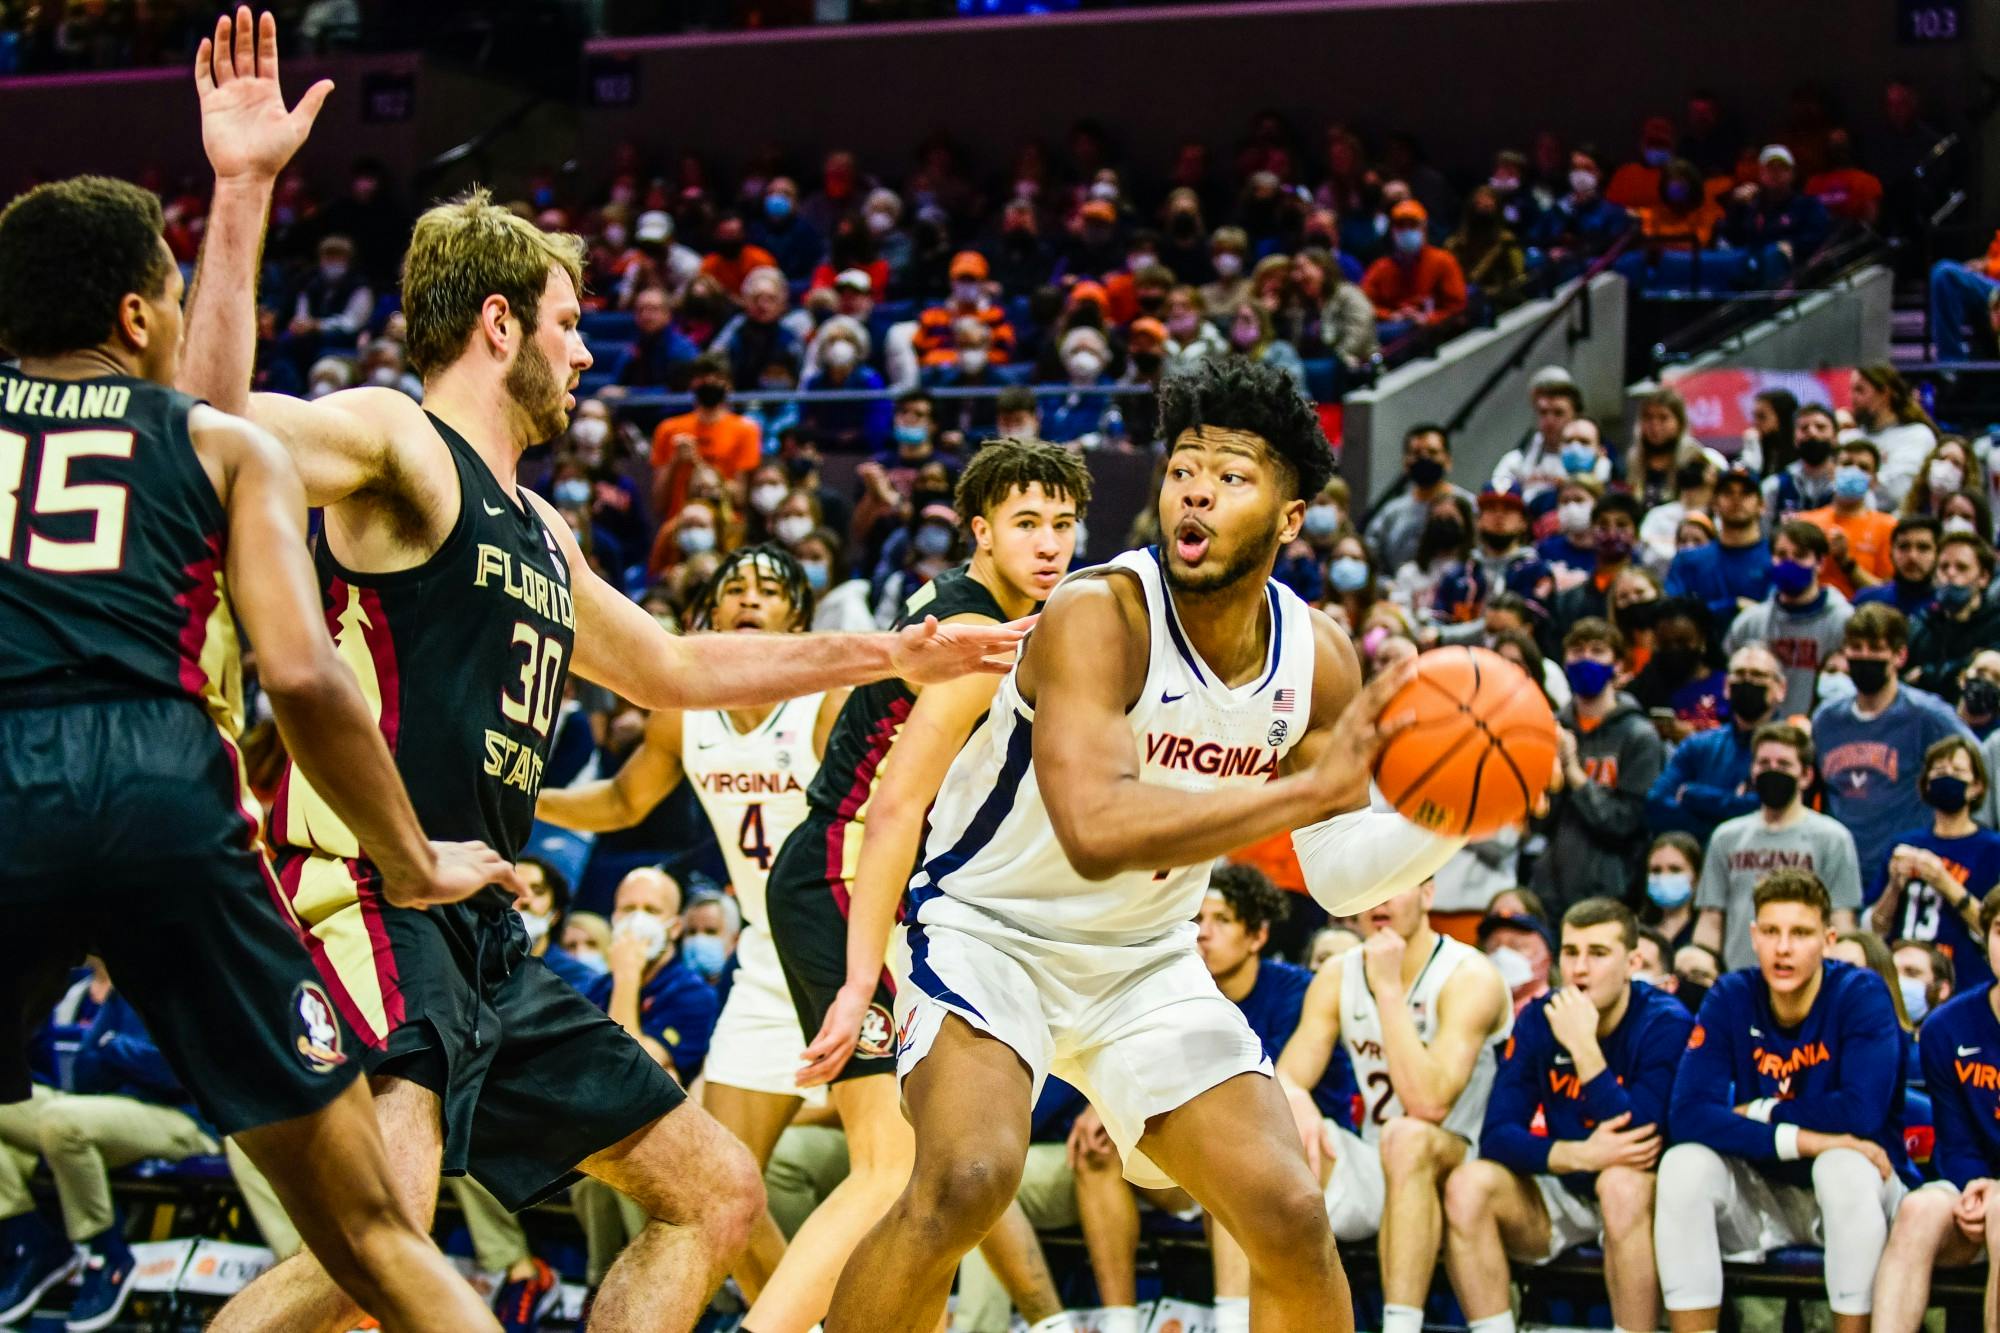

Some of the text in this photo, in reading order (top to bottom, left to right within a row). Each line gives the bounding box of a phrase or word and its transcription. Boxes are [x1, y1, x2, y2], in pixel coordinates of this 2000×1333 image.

[0, 376, 131, 419] VELAND
[474, 543, 576, 632] FLORID
[502, 621, 564, 738] 30
[695, 772, 805, 793] VIRGINIA
[1146, 732, 1280, 785] VIRGINIA
[738, 803, 773, 870] 4
[1902, 882, 1942, 941] 13
